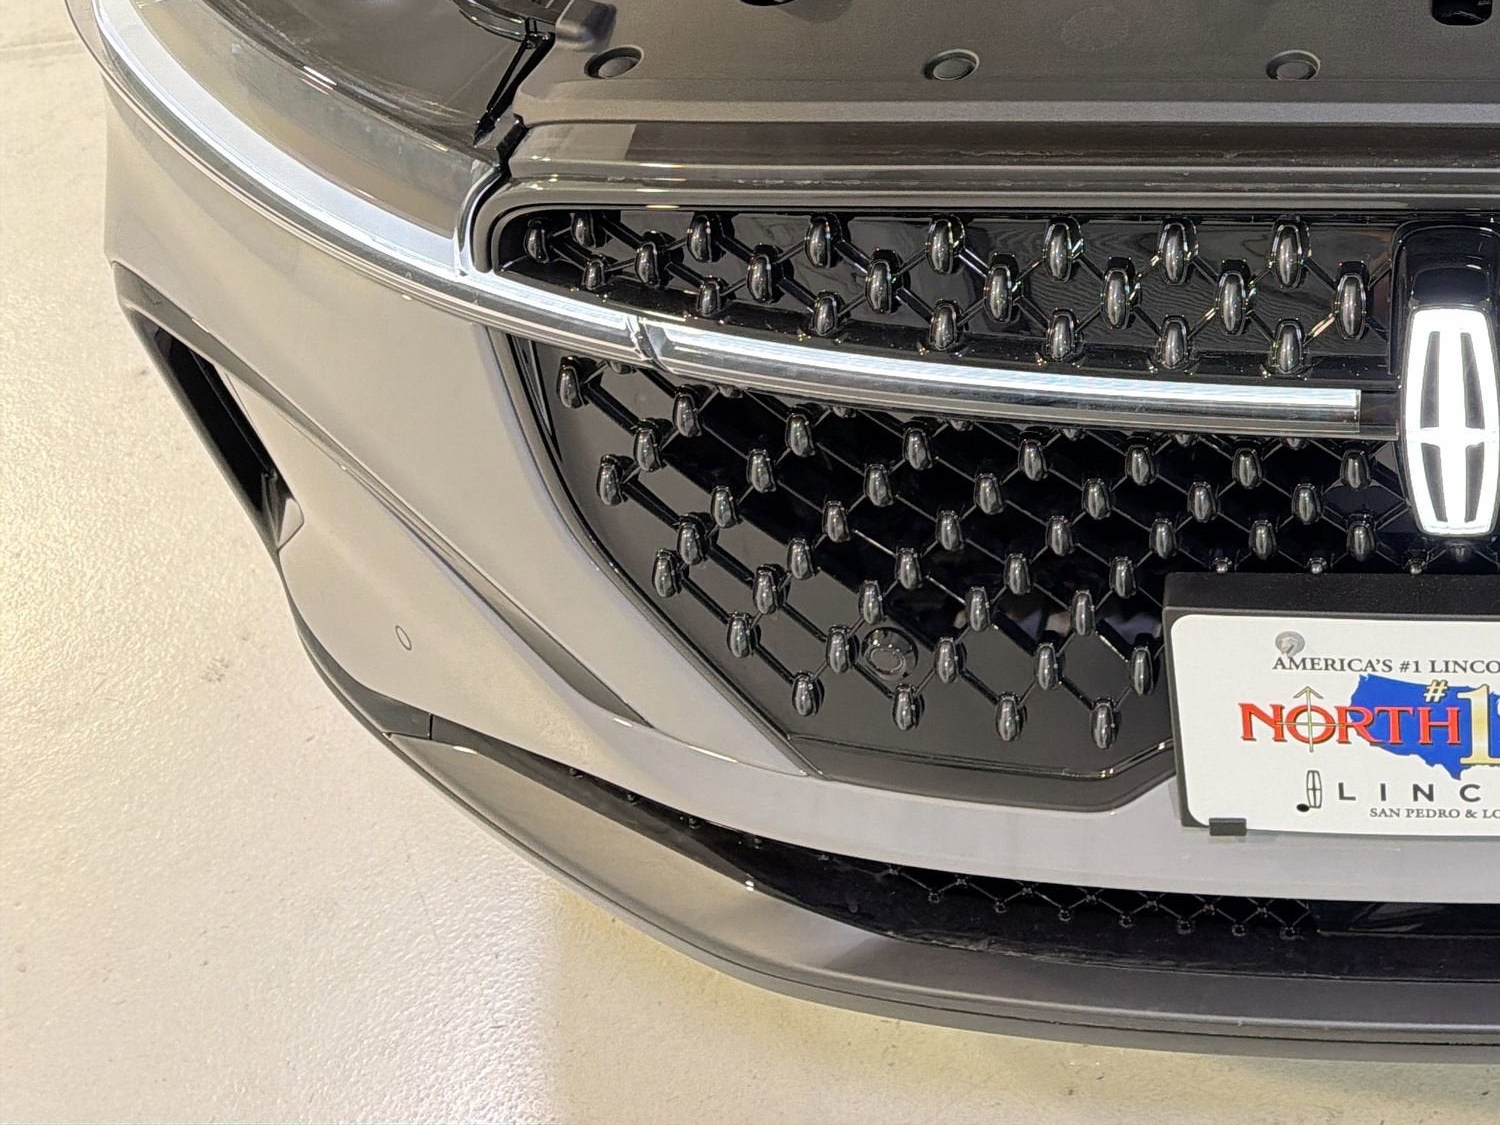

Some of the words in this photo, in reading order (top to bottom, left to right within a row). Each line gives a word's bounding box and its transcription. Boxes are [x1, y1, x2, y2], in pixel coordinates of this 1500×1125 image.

[1272, 656, 1393, 673] AMERICA'S
[1399, 660, 1422, 674] #1
[1238, 703, 1462, 746] NORTH
[1369, 807, 1400, 819] SAN
[1406, 808, 1460, 819] PEDRO
[1465, 809, 1478, 819] &
